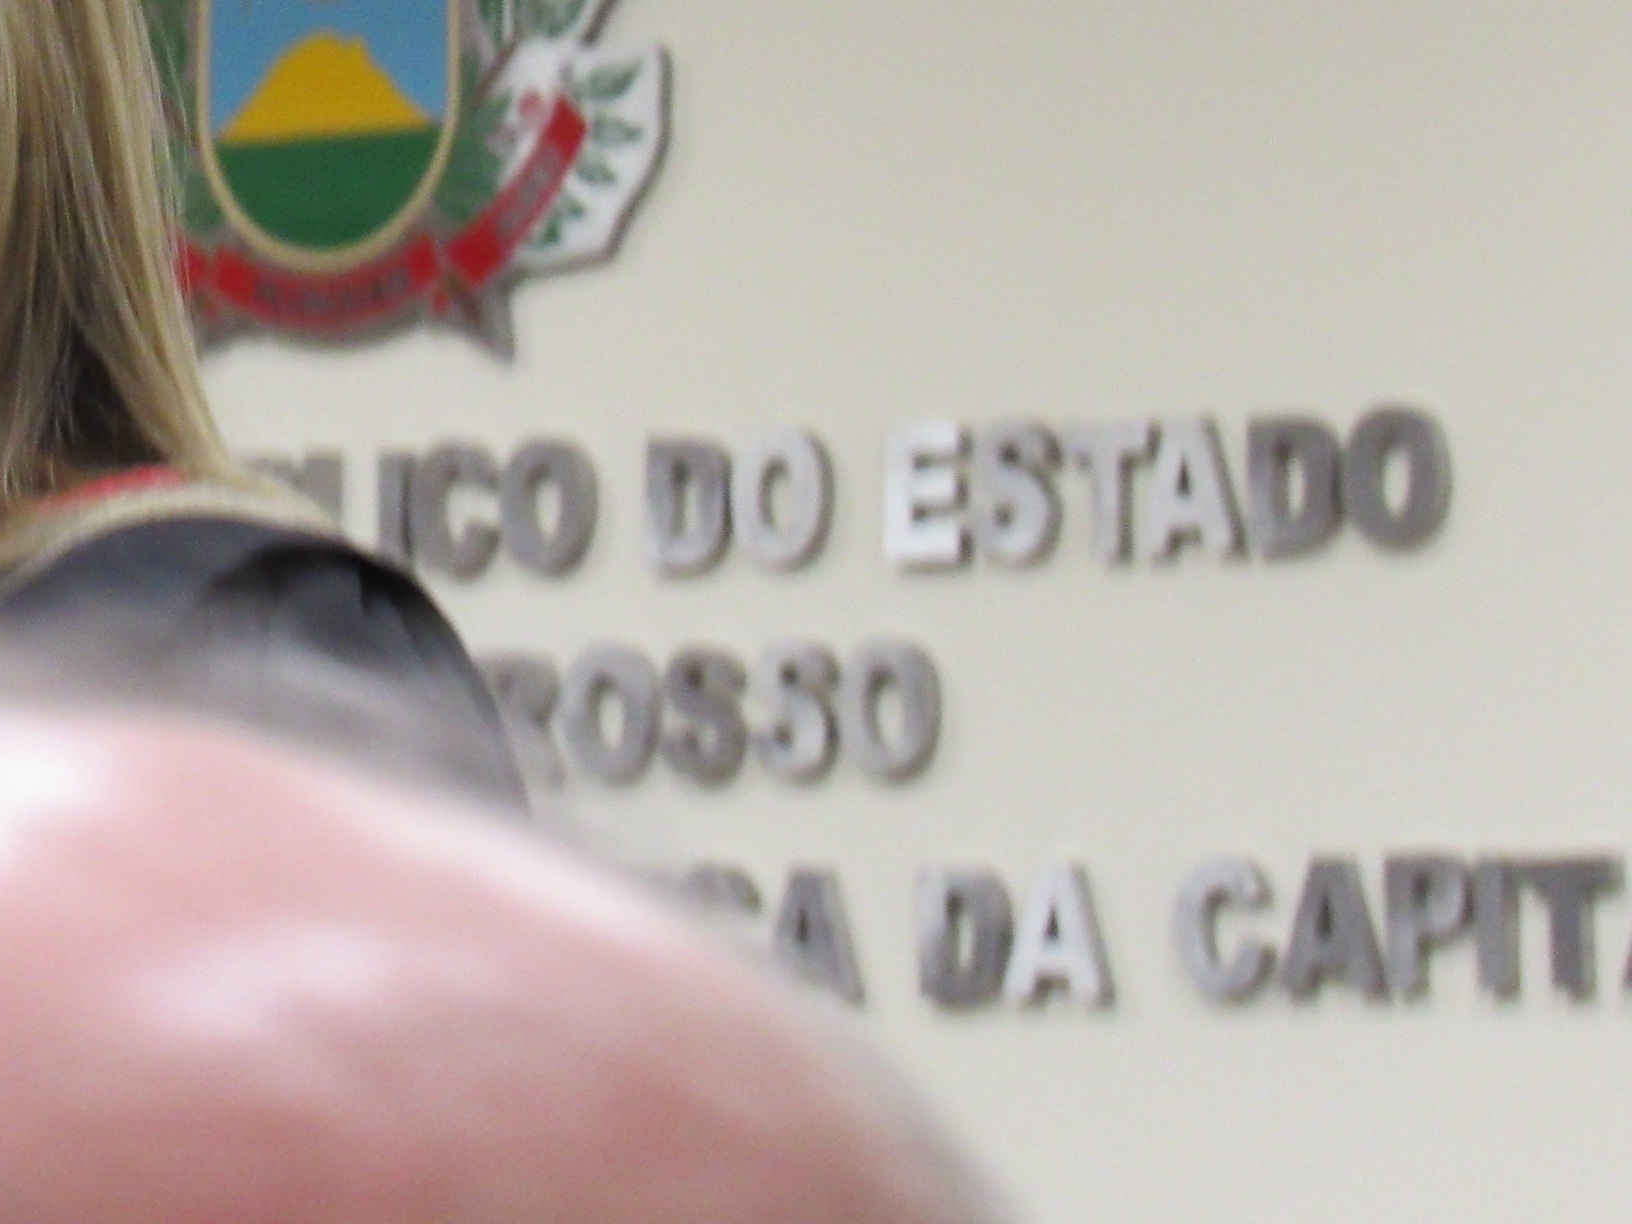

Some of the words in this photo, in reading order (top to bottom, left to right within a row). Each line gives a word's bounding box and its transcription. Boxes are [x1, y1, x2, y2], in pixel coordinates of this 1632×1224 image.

[644, 426, 836, 578] DO
[882, 402, 1454, 576] ESTADO
[914, 858, 1120, 1012] DA
[1174, 850, 1632, 1010] CAPIT
